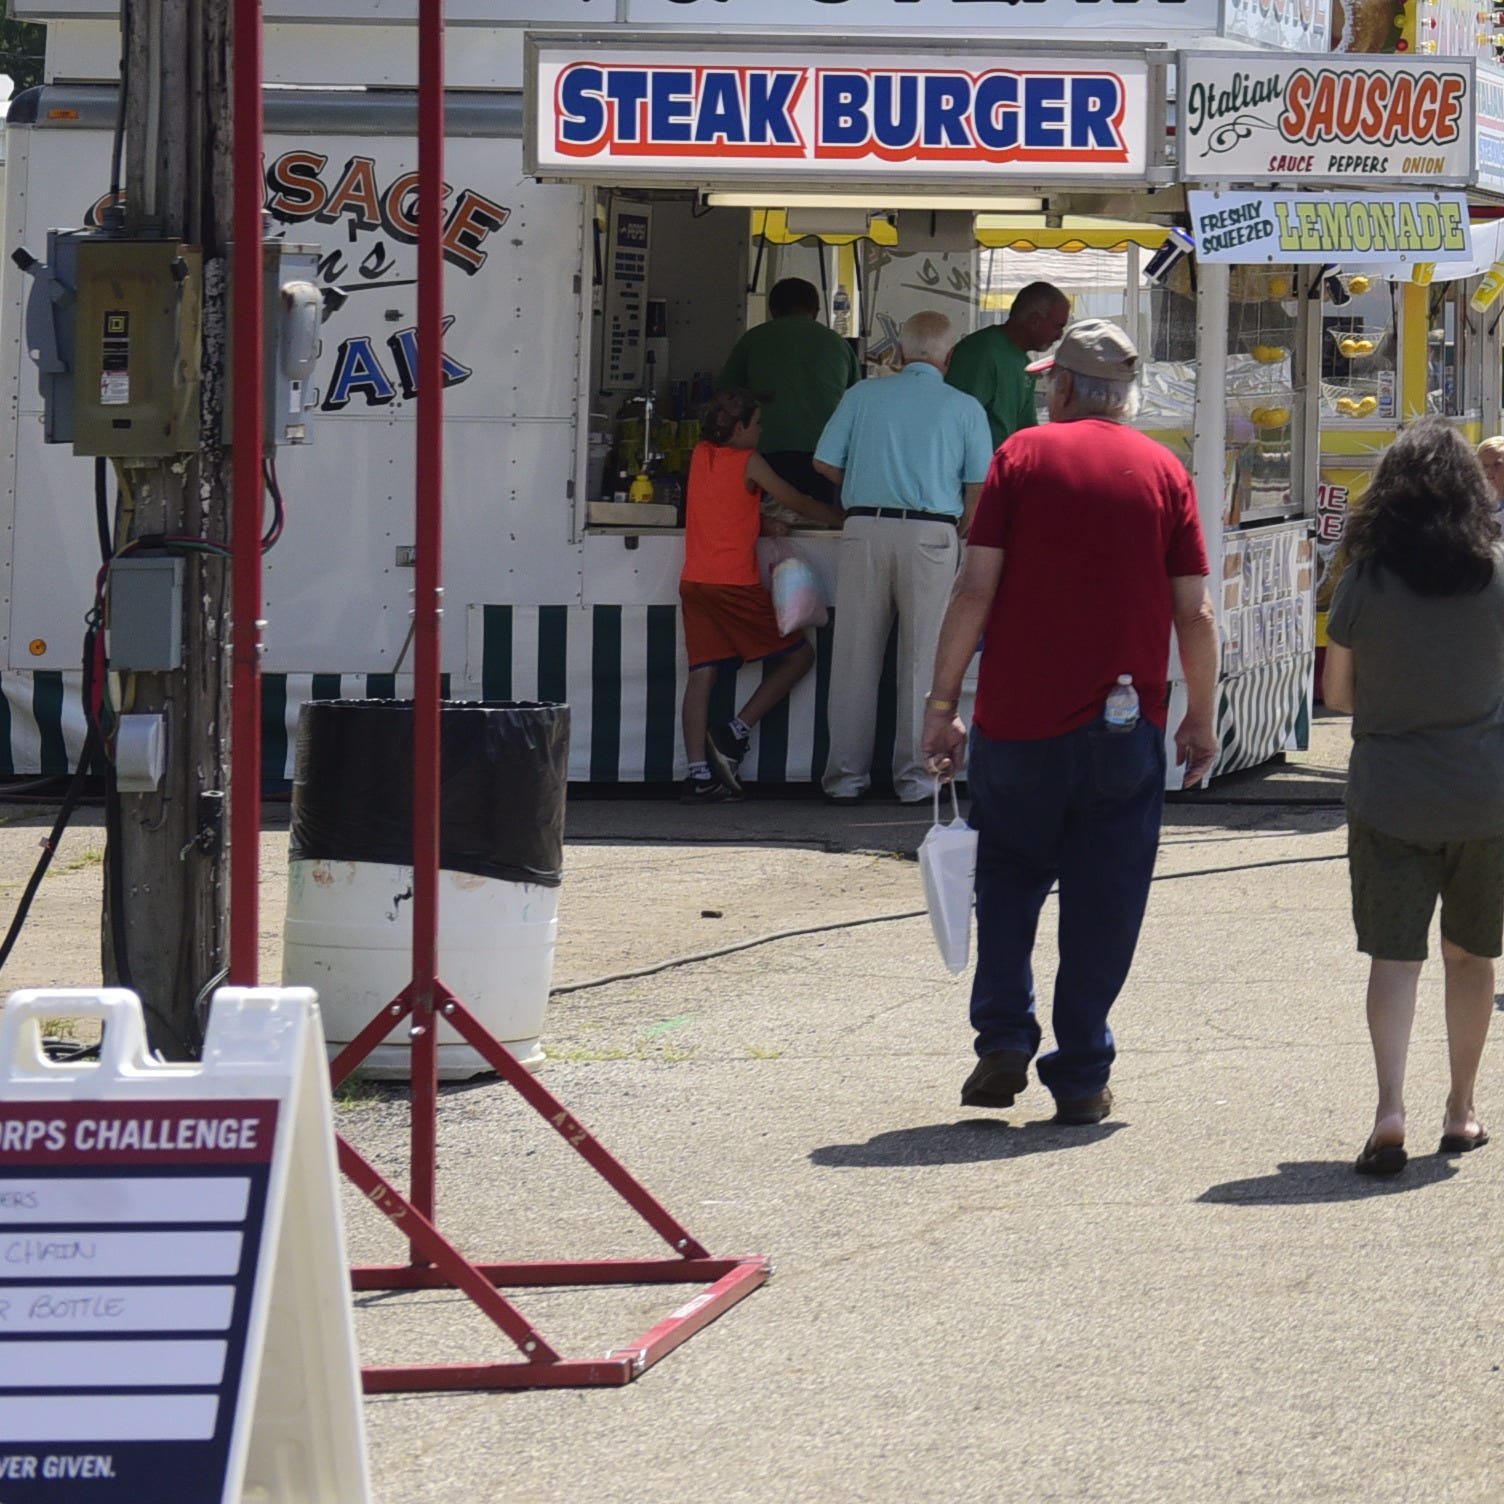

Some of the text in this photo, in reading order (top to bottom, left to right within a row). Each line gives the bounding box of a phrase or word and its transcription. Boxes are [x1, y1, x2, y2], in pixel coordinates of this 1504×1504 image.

[555, 62, 1128, 163] STEAK BURGER
[1188, 71, 1283, 135] Italian
[1277, 67, 1466, 146] SAUSAGE
[1267, 155, 1446, 174] SAUCE PEPPERS ONION
[1200, 200, 1467, 253] FRESHLY LEMONADE
[1202, 219, 1274, 255] SQUEEZED
[0, 1118, 260, 1151] RPS CHALLENGE
[28, 1296, 126, 1320] BOTTLE
[42, 1455, 117, 1479] GIVEN.
